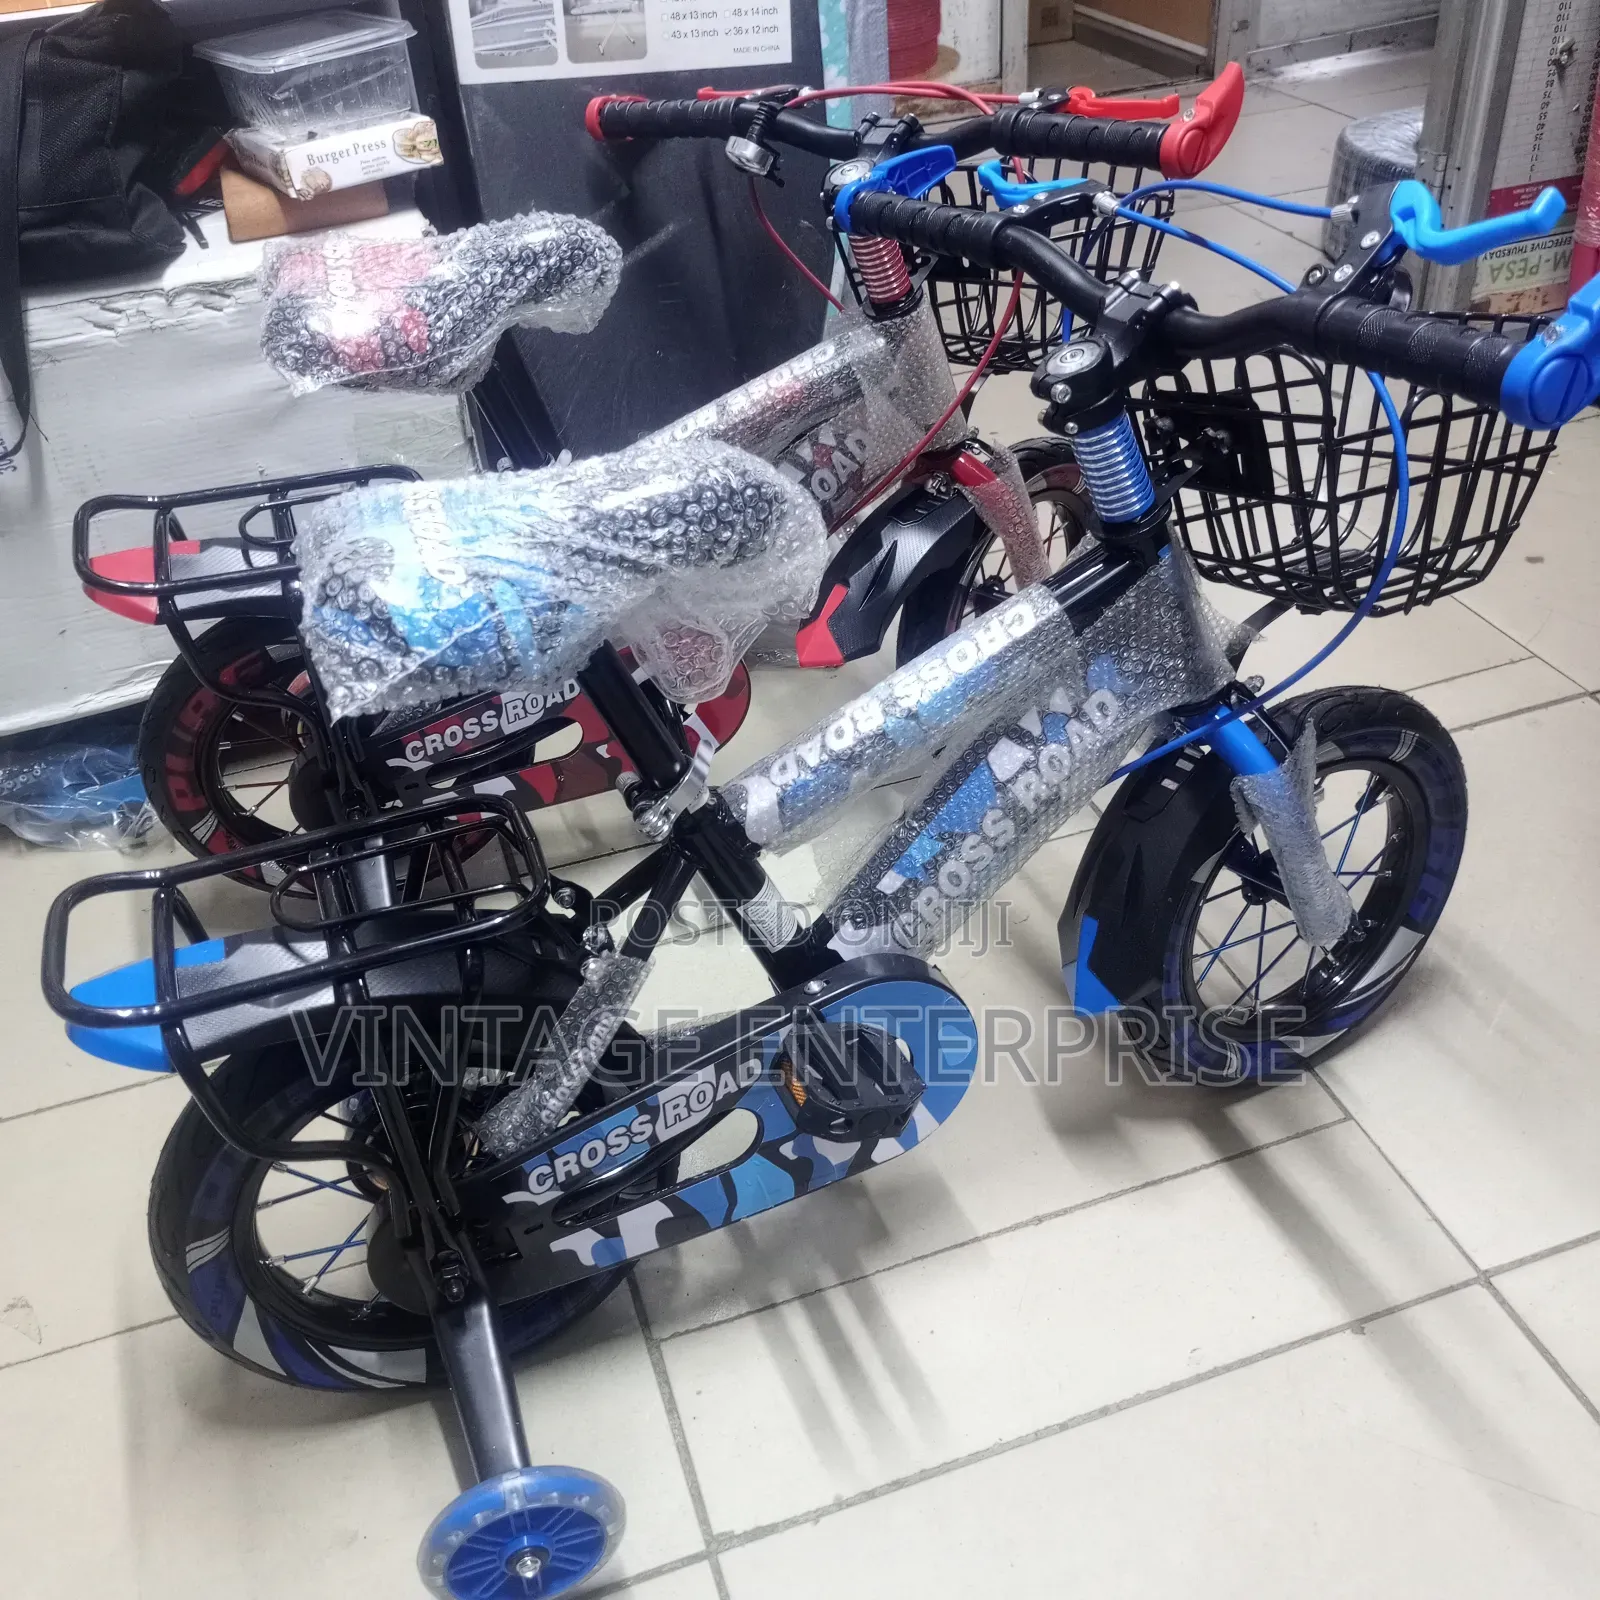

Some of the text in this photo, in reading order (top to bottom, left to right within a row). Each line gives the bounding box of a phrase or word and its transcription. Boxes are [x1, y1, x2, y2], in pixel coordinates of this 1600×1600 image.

[670, 11, 681, 20] 48
[689, 11, 699, 19] 13
[700, 10, 718, 20] inch
[732, 8, 743, 17] 48
[751, 7, 760, 16] 14
[761, 6, 778, 16] inch
[671, 31, 681, 39] 43
[690, 30, 700, 38] 13
[701, 28, 719, 38] inch
[733, 26, 743, 35] 36
[751, 25, 761, 34] 12
[762, 24, 779, 34] inch
[733, 46, 751, 54] MADE
[306, 148, 350, 167] Burger
[352, 139, 387, 156] Press
[1481, 236, 1572, 261] EFFECTIVE THURSDAY
[1489, 250, 1573, 284] M-PESA
[769, 603, 1037, 788] CROSS ROAD
[405, 678, 581, 762] CROSS ROAD
[891, 688, 1120, 948] CROSS ROAD
[527, 1058, 763, 1195] CROSS ROAD
